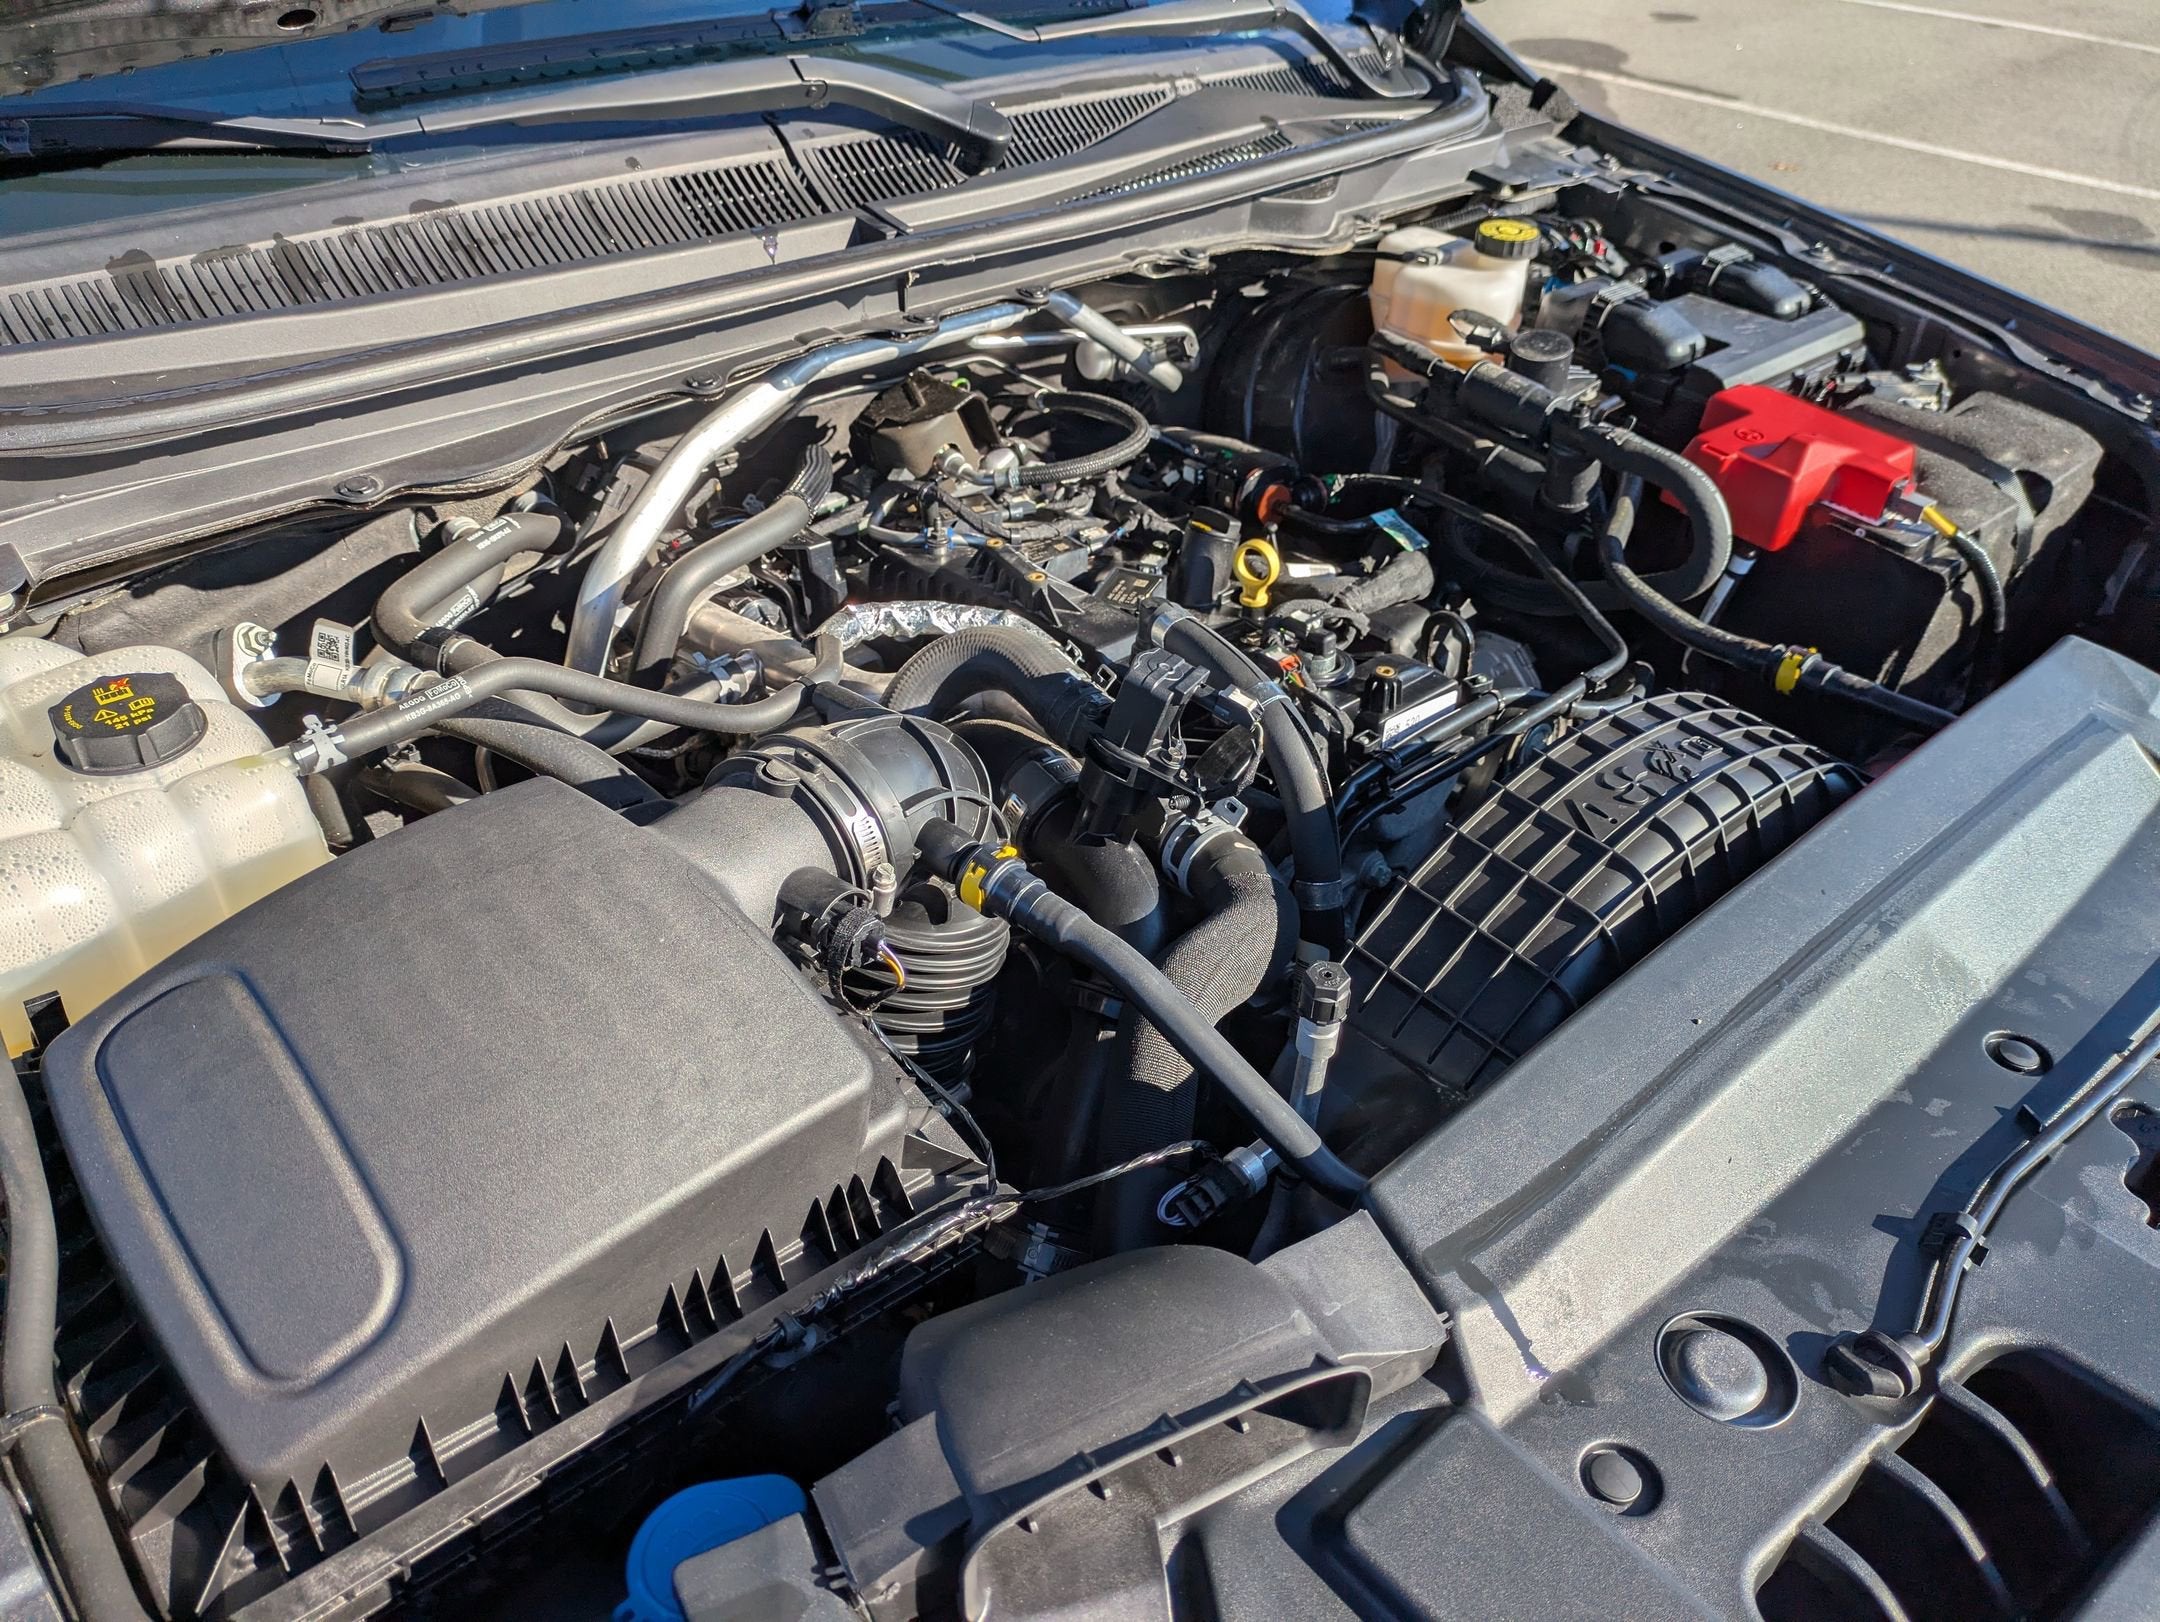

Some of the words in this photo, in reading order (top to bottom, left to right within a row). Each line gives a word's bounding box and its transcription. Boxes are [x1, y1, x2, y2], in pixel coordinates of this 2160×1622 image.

[427, 680, 458, 698] FoMoCo
[104, 714, 128, 726] 145
[130, 708, 154, 718] kPa
[114, 721, 130, 730] 21
[133, 715, 153, 726] psi
